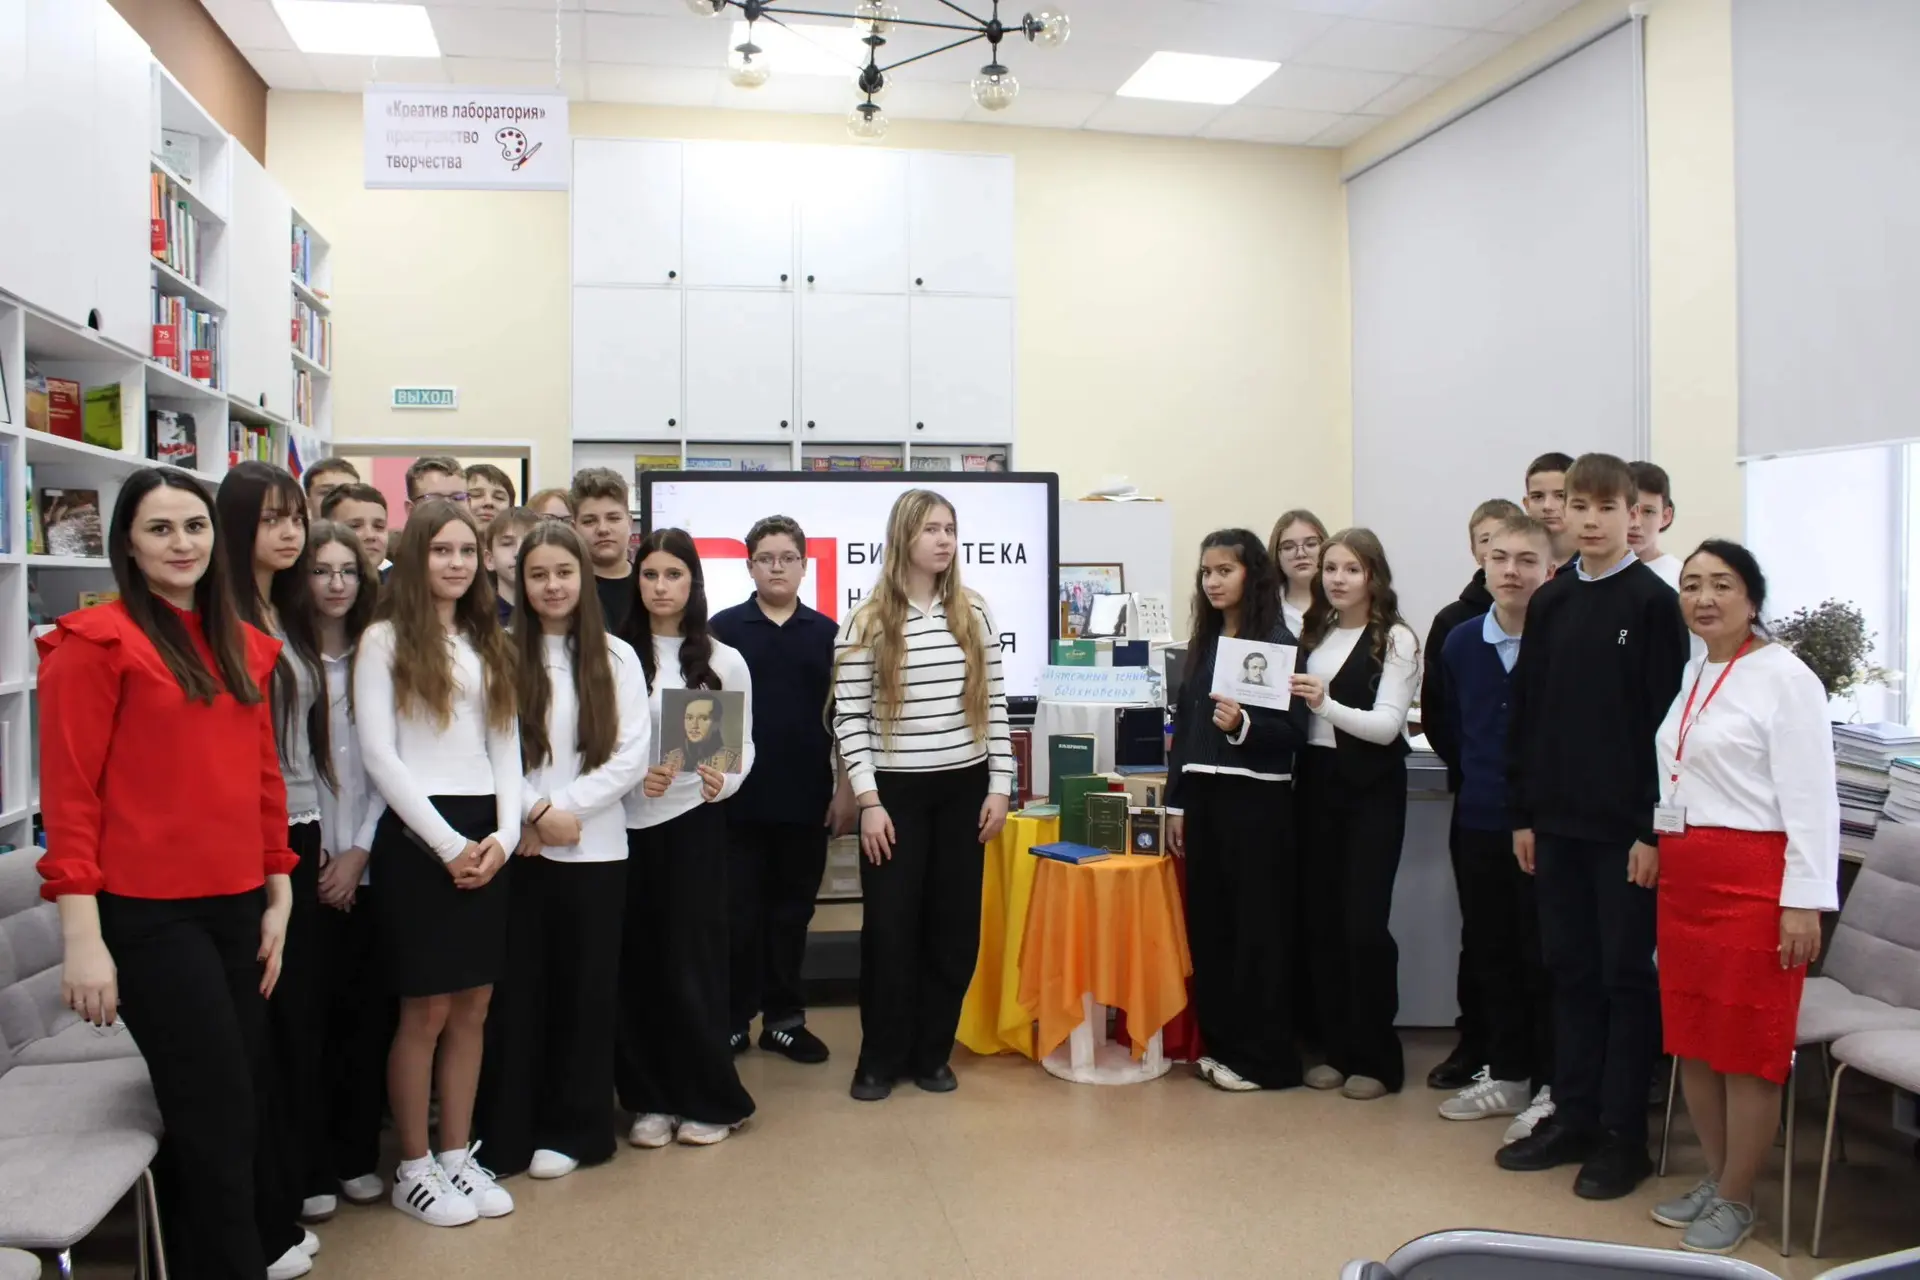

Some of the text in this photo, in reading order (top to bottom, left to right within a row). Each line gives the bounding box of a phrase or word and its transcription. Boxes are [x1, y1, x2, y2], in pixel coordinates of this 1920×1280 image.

[386, 100, 546, 123] «Креатив лаборатория»
[386, 154, 462, 172] творчества
[398, 390, 450, 404] ВЫХОД
[848, 542, 1028, 565] БИТЕКА
